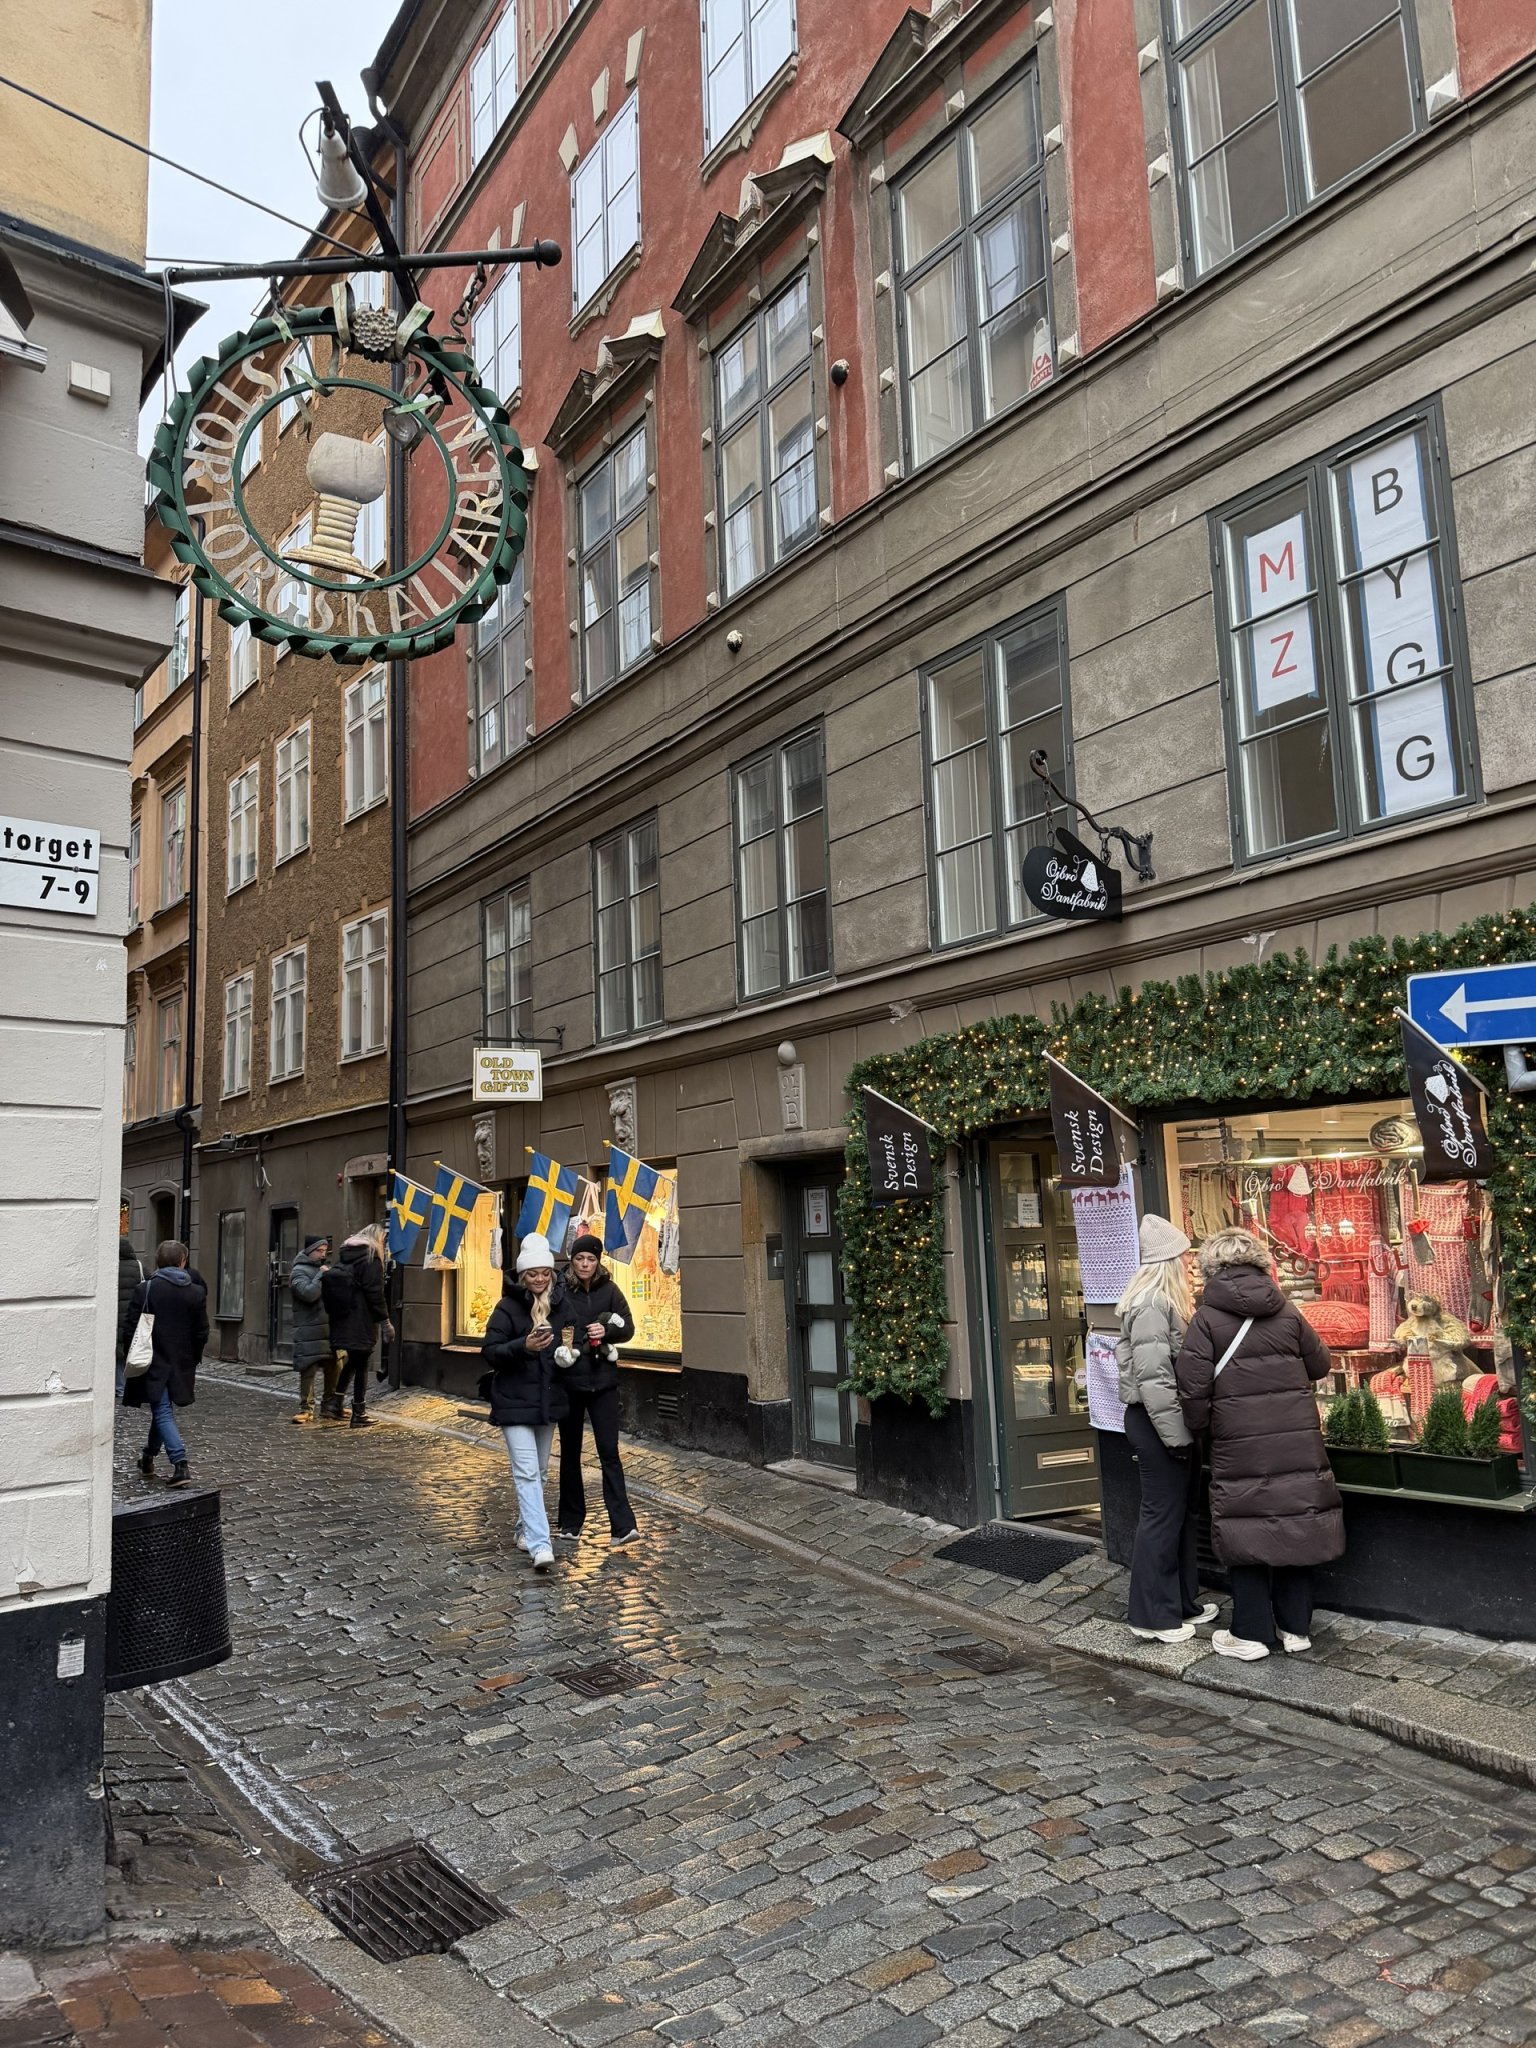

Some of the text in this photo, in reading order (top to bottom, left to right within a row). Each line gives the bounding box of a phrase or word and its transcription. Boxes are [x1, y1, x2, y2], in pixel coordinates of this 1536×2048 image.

[4, 827, 92, 862] torget
[40, 875, 90, 904] 7-9
[480, 1057, 513, 1068] OLD
[490, 1069, 534, 1081] TOWN
[480, 1081, 529, 1092] GIFTS
[1064, 1110, 1086, 1175] Svensk
[1086, 1109, 1104, 1175] Design
[879, 1134, 900, 1190] Svensk
[900, 1131, 918, 1189] Design
[1353, 1249, 1409, 1281] JUL
